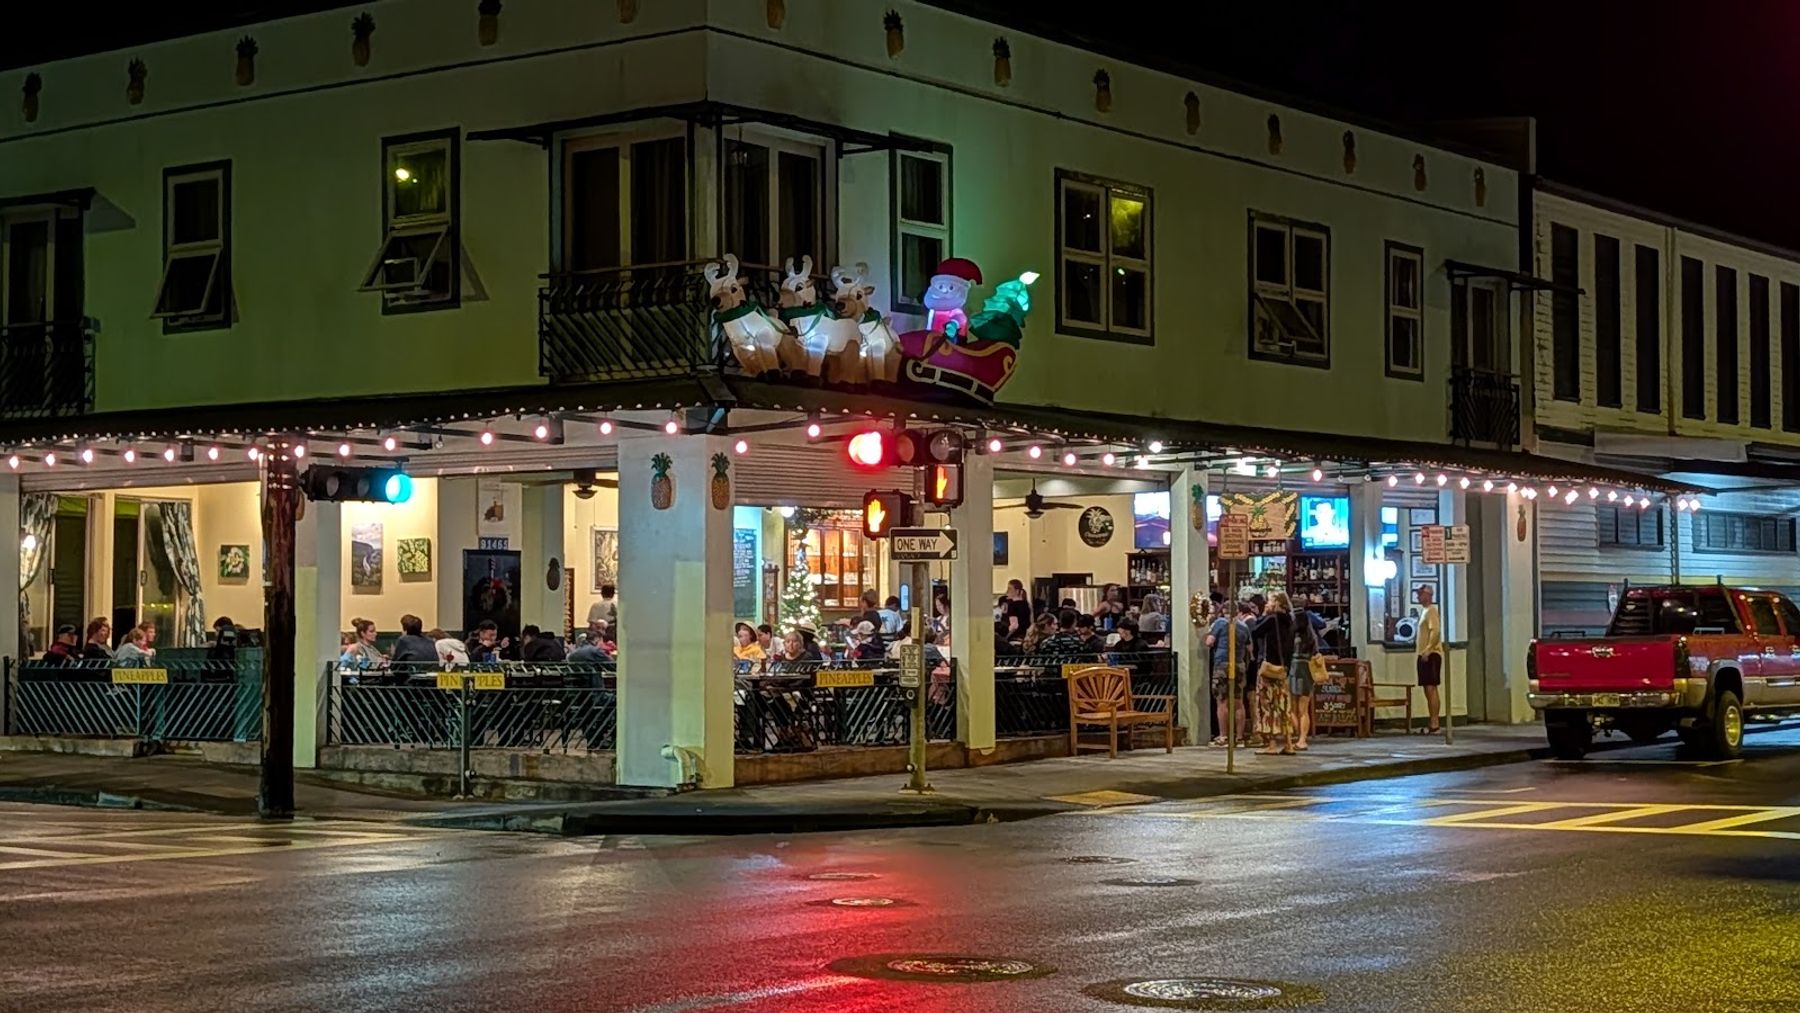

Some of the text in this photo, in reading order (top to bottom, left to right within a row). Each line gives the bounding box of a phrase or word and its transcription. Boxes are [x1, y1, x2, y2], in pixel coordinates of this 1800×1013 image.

[897, 538, 938, 550] ONE WAY
[440, 674, 503, 687] PINPLES
[819, 672, 871, 685] PINEAPPLES
